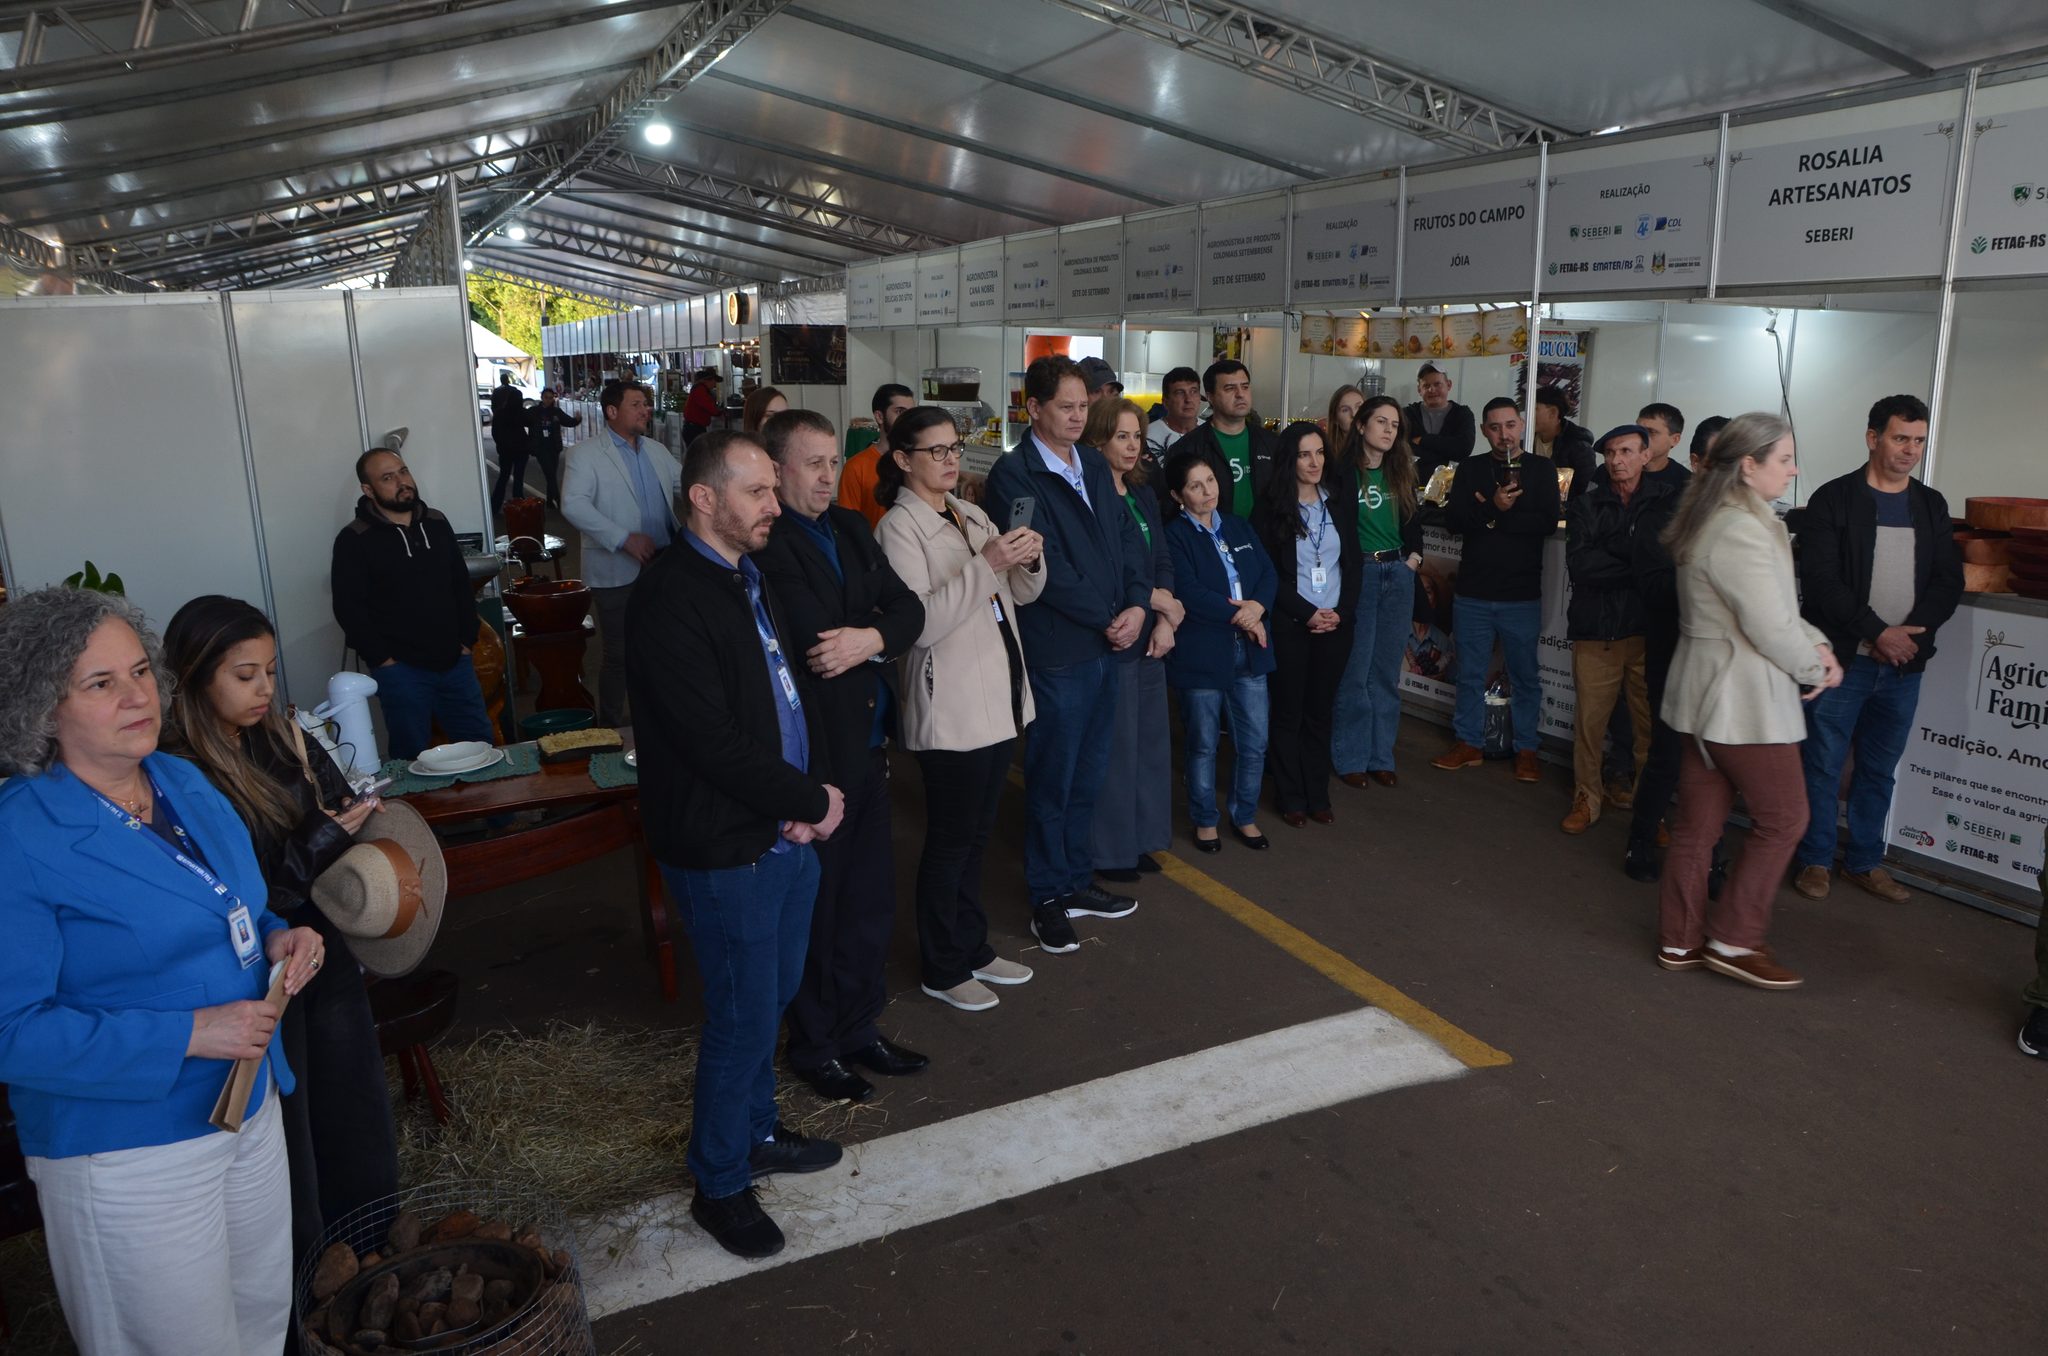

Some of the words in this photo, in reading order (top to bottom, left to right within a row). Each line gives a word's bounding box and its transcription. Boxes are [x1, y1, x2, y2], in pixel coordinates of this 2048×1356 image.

[1798, 145, 1883, 173] ROSALIA
[1600, 183, 1651, 200] REALIZAÇÃO
[1768, 174, 1912, 206] ARTESANATOS
[1413, 213, 1456, 231] FRUTOS
[1459, 211, 1476, 226] DO
[1479, 205, 1525, 224] CAMPO
[1667, 217, 1682, 228] CDL
[1582, 226, 1611, 239] SEBERI
[1805, 227, 1854, 243] SEBERI
[1991, 234, 2047, 250] FETAG-RS
[1450, 253, 1470, 268] JÓIA
[1559, 263, 1589, 274] FETAG-RS
[1593, 259, 1634, 272] EMATER/RS
[1212, 276, 1225, 286] SETE
[1225, 275, 1234, 285] DE
[1234, 272, 1266, 284] SETEMBRO
[1921, 727, 2002, 759] Tradição.
[1909, 763, 1931, 776] Três
[1933, 769, 1967, 786] pilares
[1969, 780, 1989, 792] que
[1990, 786, 2003, 795] se
[1931, 786, 1954, 800] Esse
[1956, 792, 1963, 802] é
[1964, 796, 1971, 804] o
[1973, 797, 2001, 811] valor
[2002, 805, 2016, 817] da
[1963, 820, 2006, 841] SEBERI
[1960, 844, 1999, 865] FETAG-RS
